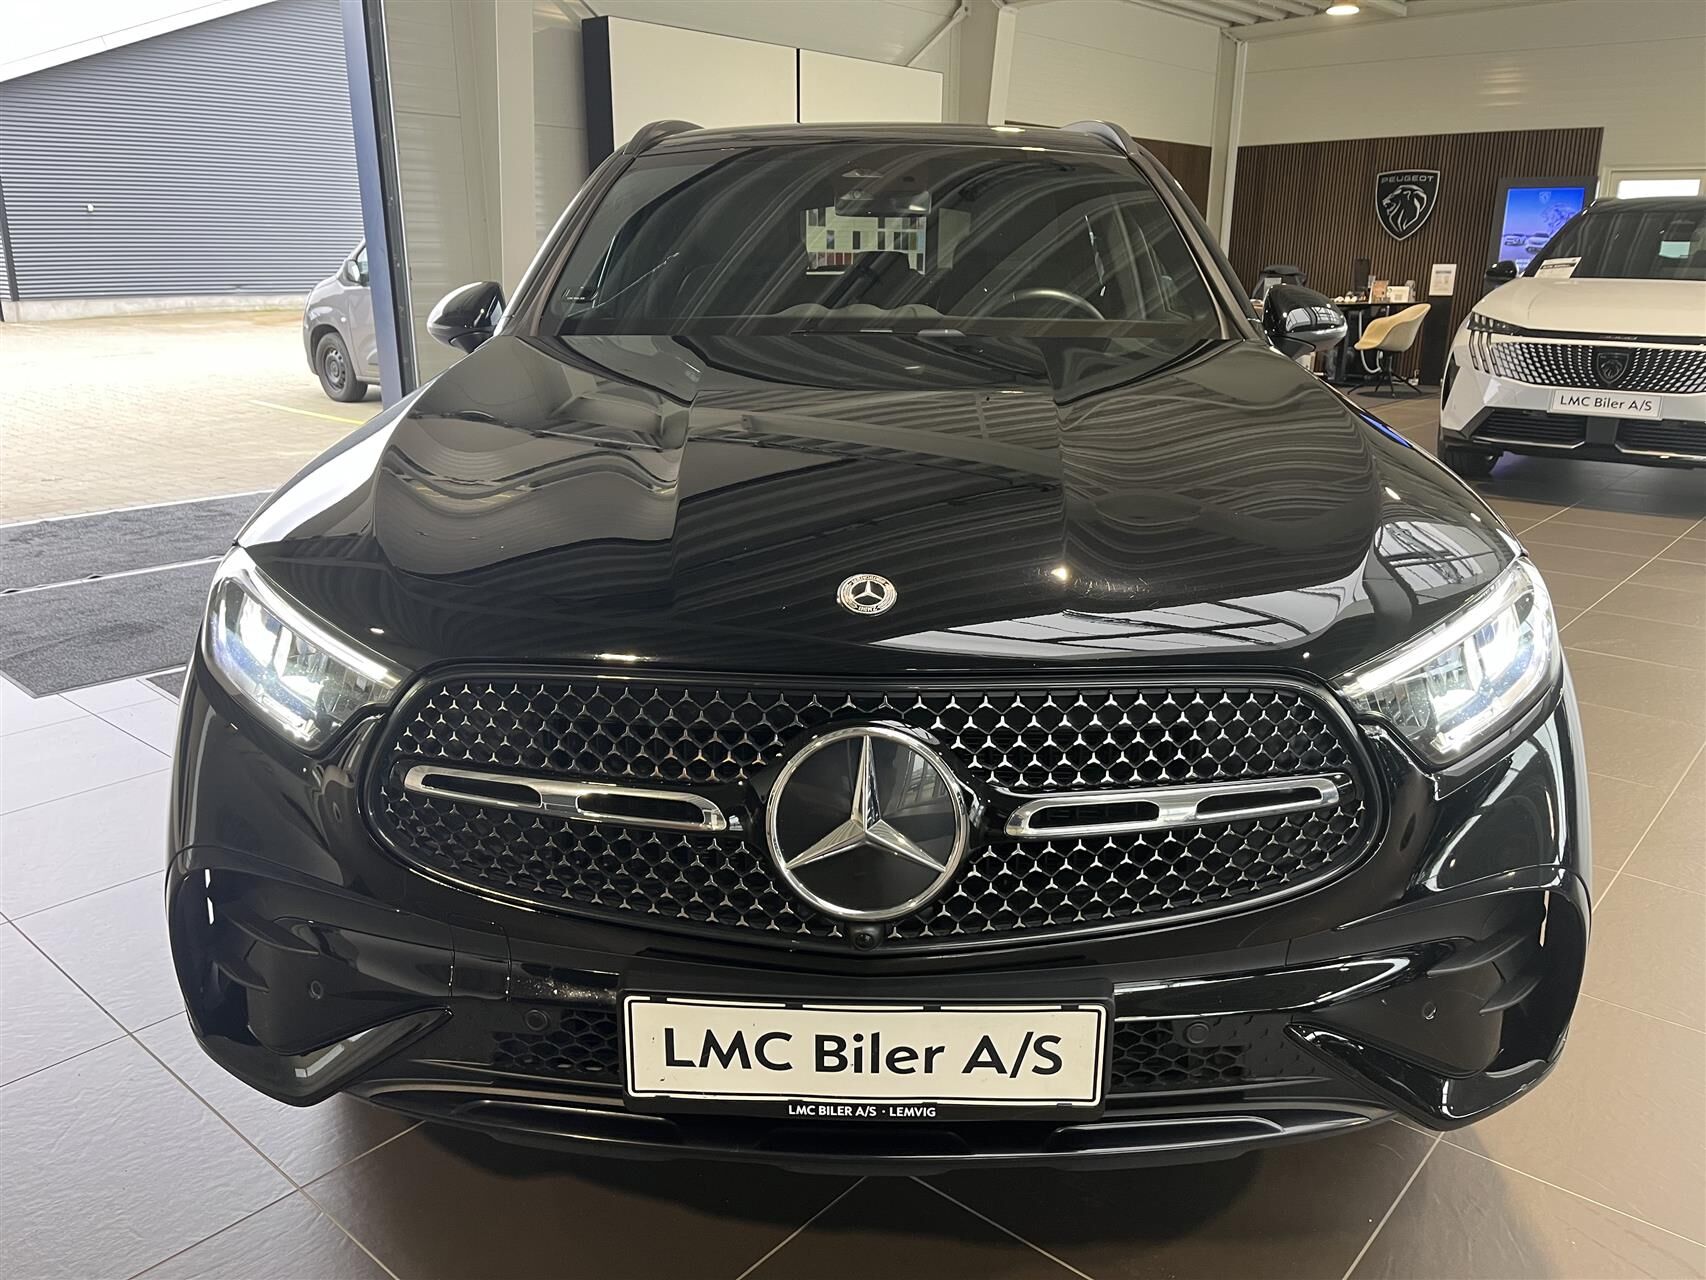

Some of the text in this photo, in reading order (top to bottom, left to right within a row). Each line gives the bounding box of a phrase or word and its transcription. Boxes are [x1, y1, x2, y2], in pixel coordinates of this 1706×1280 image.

[1381, 175, 1434, 183] PEUGEOT
[1560, 395, 1653, 412] LMC Biler A/S
[664, 1027, 1063, 1078] LMC Biler A/S
[788, 1105, 936, 1118] LMC BILER A/S LEMVIG
